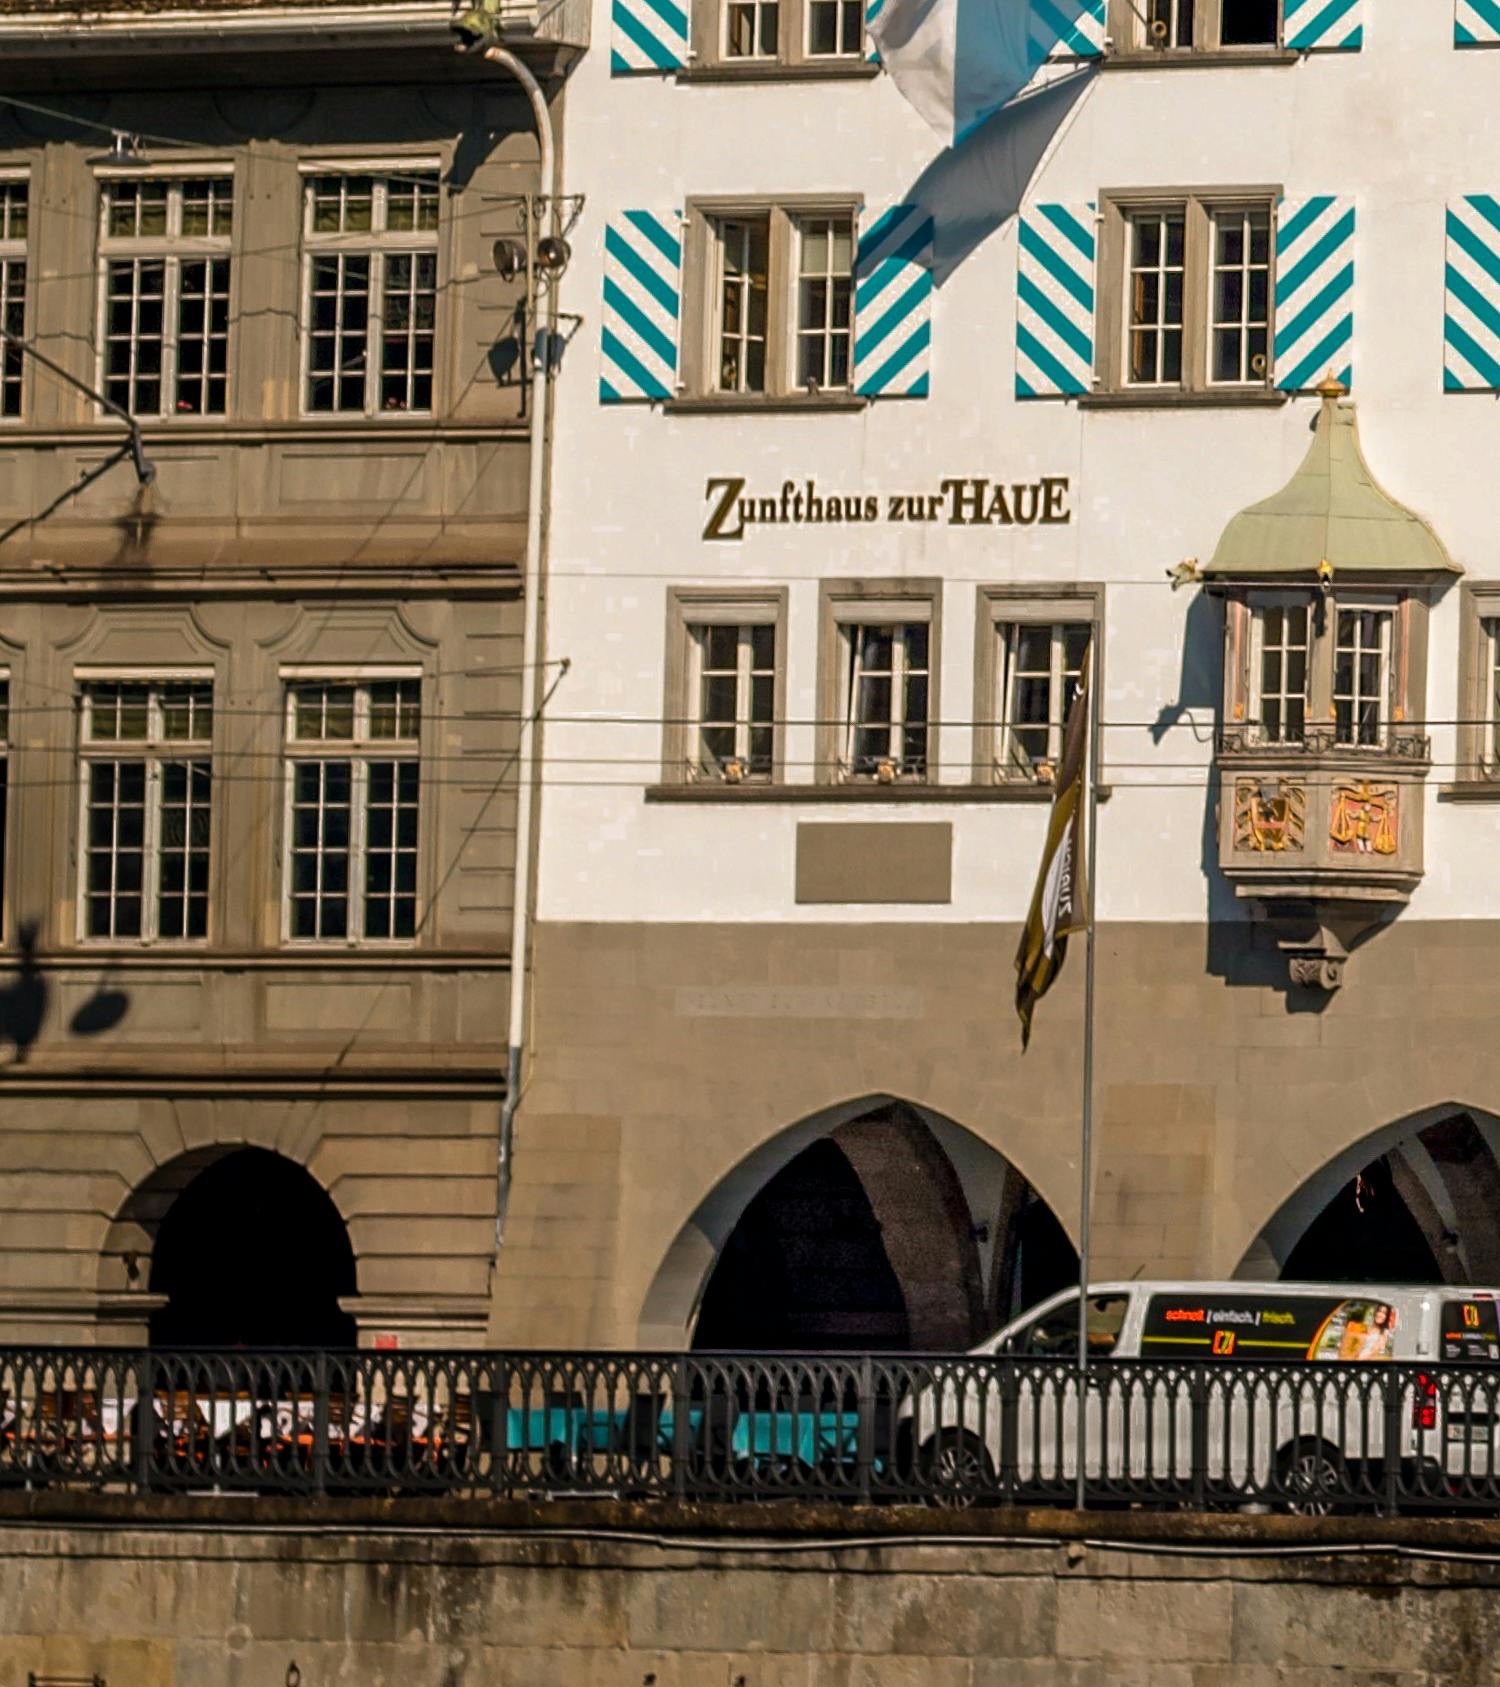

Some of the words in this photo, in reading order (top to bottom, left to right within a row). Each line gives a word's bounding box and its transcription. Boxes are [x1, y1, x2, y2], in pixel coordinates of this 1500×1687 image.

[702, 477, 878, 541] Zunfthaus
[887, 496, 943, 522] zur
[941, 477, 1071, 525] HAUE
